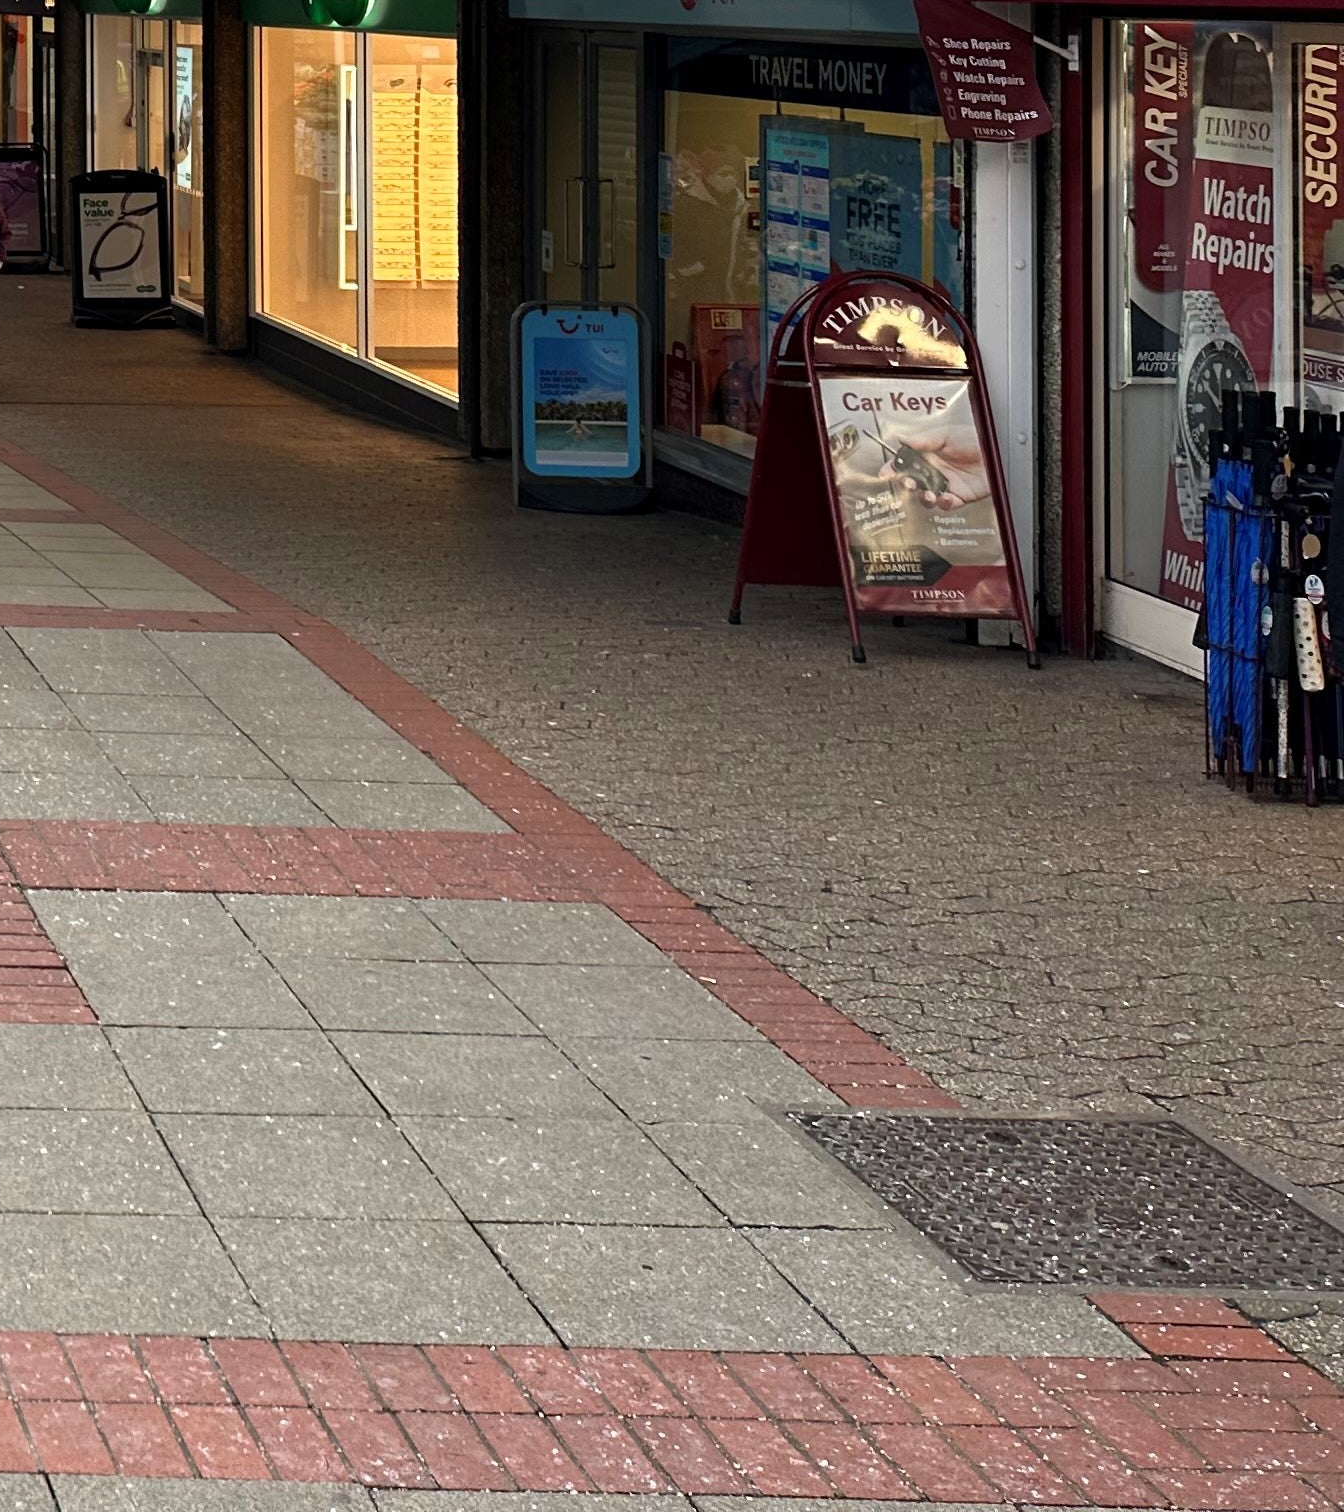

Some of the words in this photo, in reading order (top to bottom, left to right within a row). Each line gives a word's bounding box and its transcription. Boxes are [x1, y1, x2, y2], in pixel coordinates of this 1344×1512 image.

[943, 37, 969, 49] Shoe
[970, 38, 1011, 52] Repairs
[948, 54, 968, 68] Key
[969, 55, 1007, 70] Cutting
[1144, 24, 1179, 101] KEY
[749, 54, 814, 89] TRAVEL
[818, 59, 888, 96] MONEY
[953, 71, 986, 85] Watch
[987, 73, 1026, 87] Repairs
[1178, 44, 1189, 99] SPECIALIST
[957, 88, 1007, 105] Engraving
[960, 106, 993, 120] Phone
[994, 108, 1039, 124] Repairs
[973, 127, 1016, 137] TIMPSON
[1204, 116, 1271, 142] TIMPSO
[1144, 107, 1179, 188] CAR
[83, 199, 109, 208] Face
[1203, 177, 1271, 225] Watch
[84, 208, 114, 218] value
[846, 195, 902, 239] FREE
[1192, 222, 1275, 276] Repairs
[823, 296, 948, 341] TIMPSON
[585, 323, 604, 333] TUI
[1137, 351, 1179, 362] MOBILE
[1138, 362, 1167, 372] AUTO
[842, 392, 883, 412] Car
[889, 392, 948, 415] Keys
[861, 550, 922, 564] LIFETIME
[863, 563, 923, 574] GUARANTEE
[1163, 549, 1205, 592] Whil
[911, 589, 965, 599] TIMPSON
